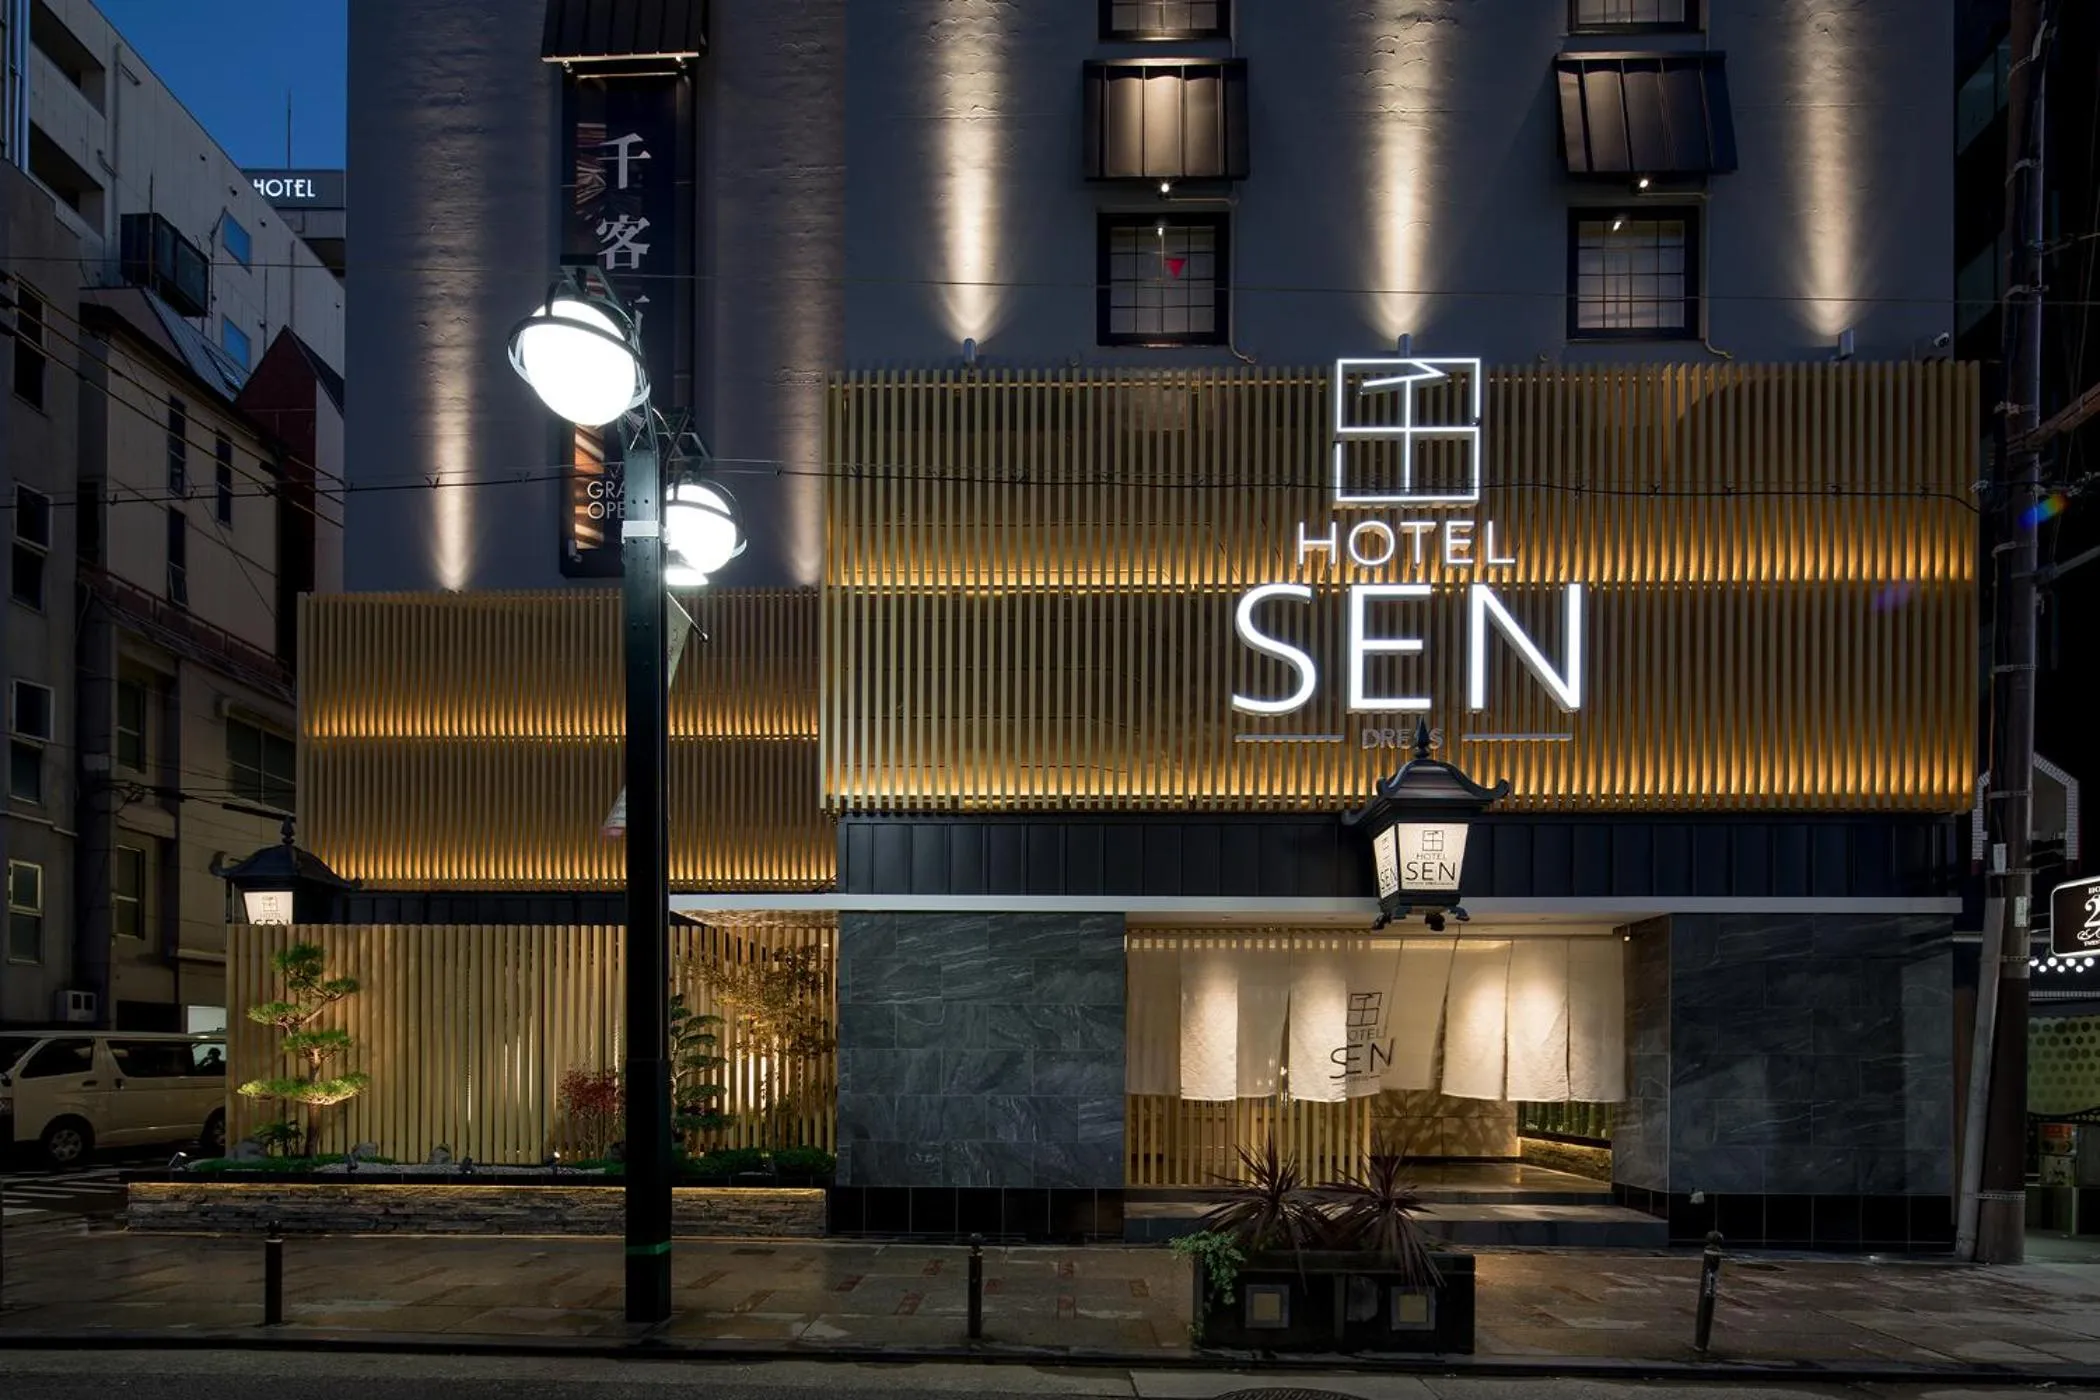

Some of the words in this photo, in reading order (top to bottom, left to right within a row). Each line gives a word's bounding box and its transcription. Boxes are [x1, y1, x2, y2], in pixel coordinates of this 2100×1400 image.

[253, 179, 316, 197] HOTEL
[1297, 520, 1516, 567] HOTEL
[1232, 583, 1583, 714] SEN
[1405, 861, 1456, 881] SEN
